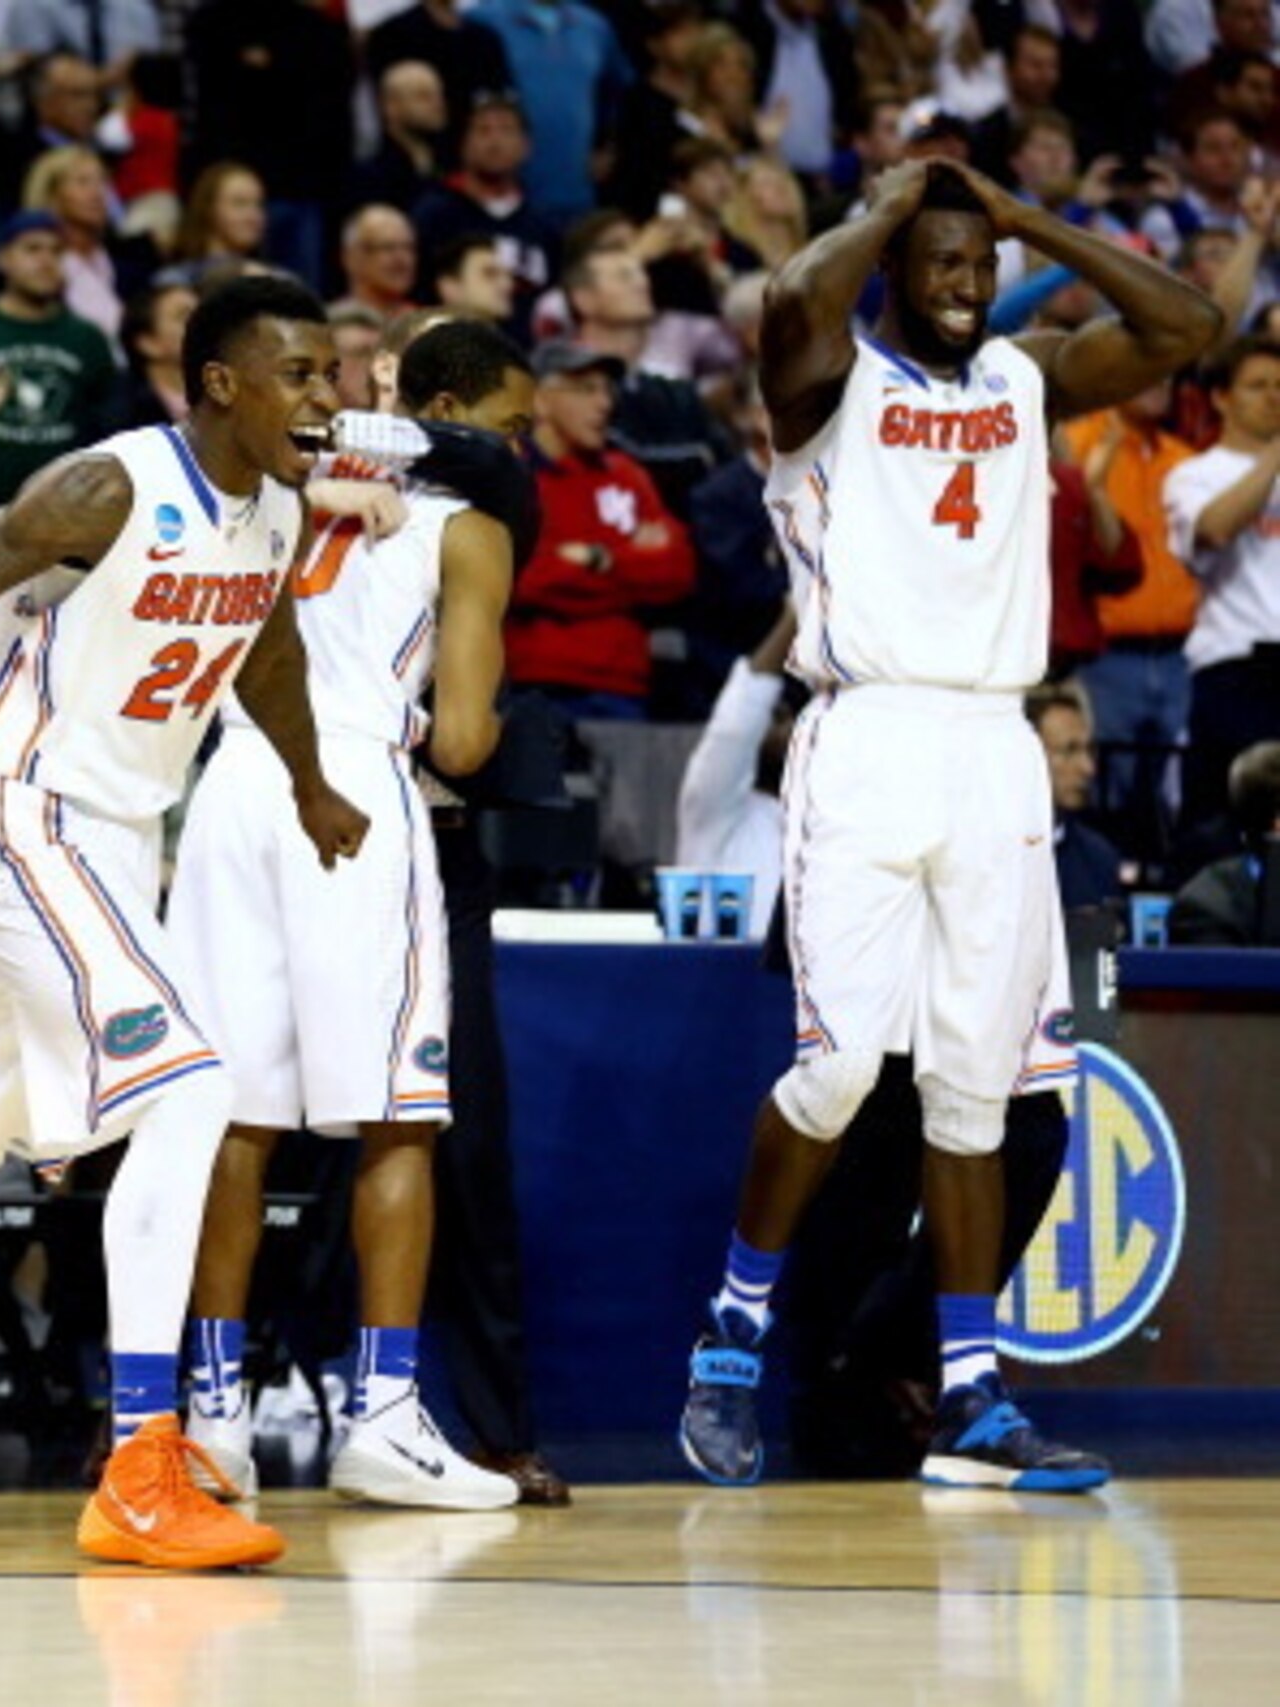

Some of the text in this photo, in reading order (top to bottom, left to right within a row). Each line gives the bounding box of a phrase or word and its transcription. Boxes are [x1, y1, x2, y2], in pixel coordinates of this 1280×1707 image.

[879, 401, 1019, 453] GATORS
[932, 462, 982, 540] 4
[119, 636, 247, 722] 24
[996, 1073, 1158, 1335] EC
